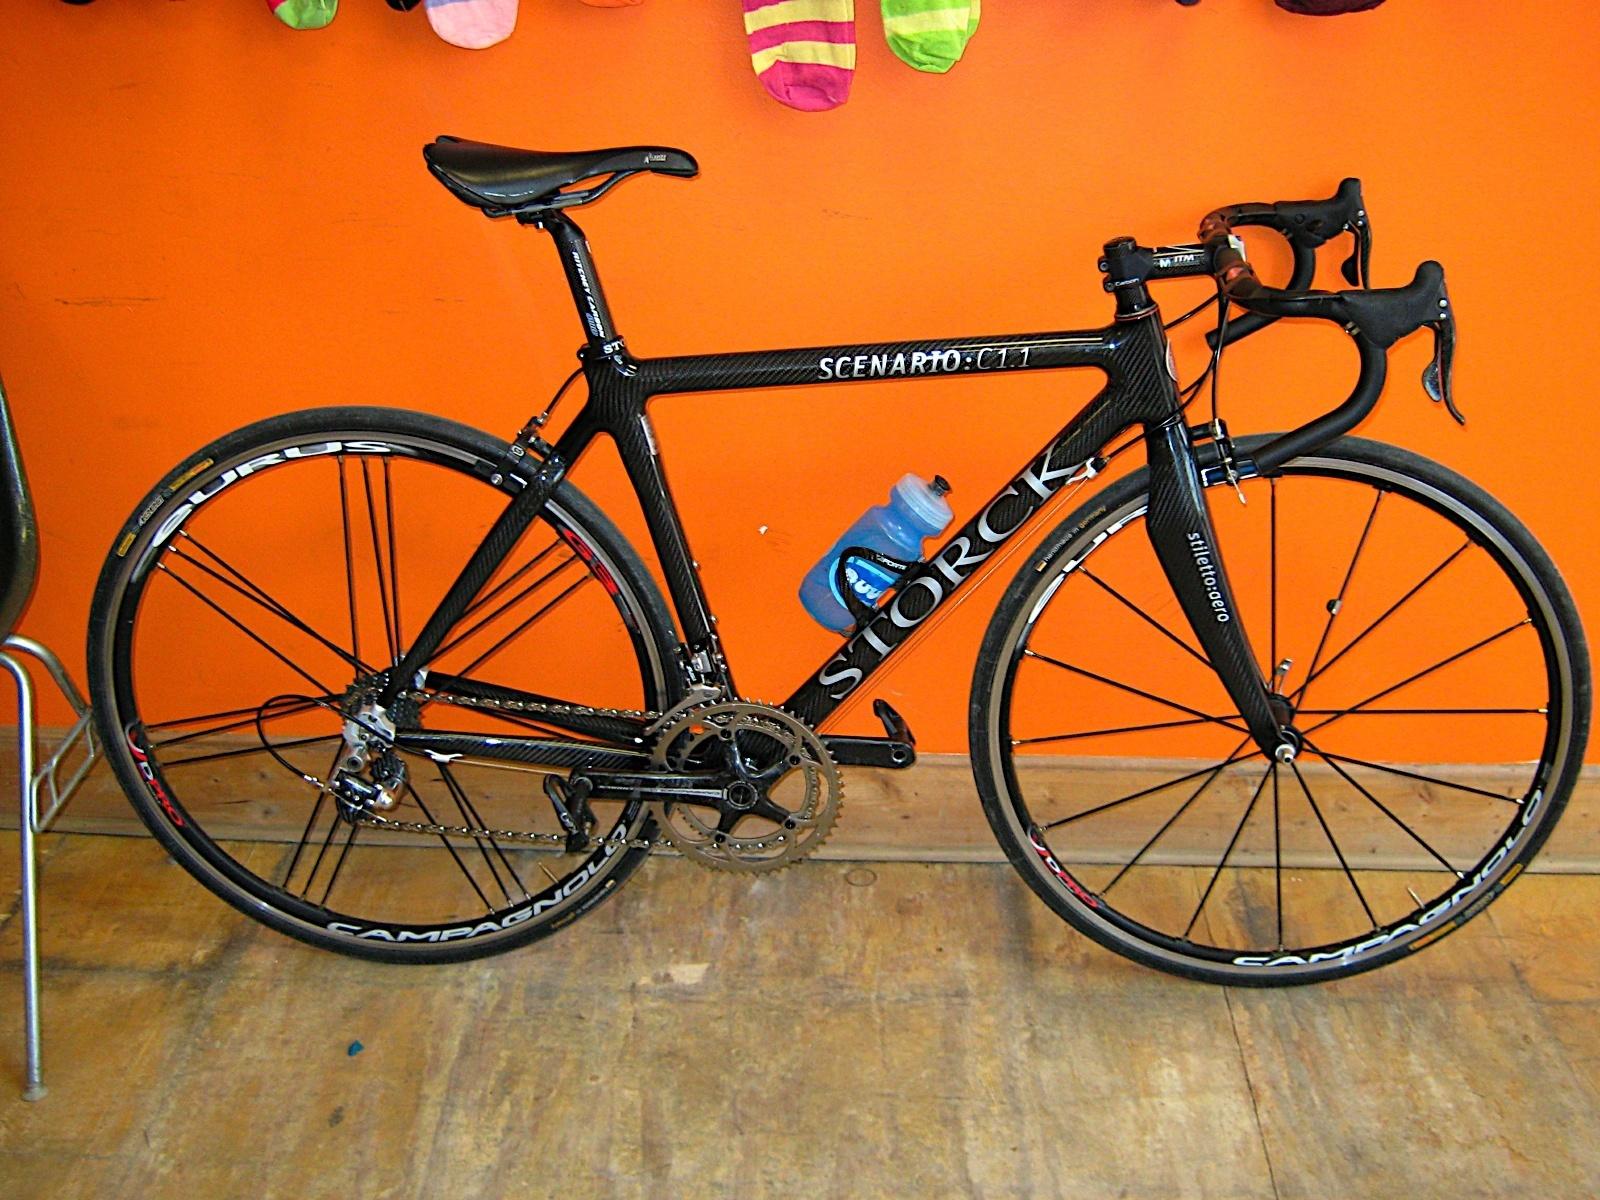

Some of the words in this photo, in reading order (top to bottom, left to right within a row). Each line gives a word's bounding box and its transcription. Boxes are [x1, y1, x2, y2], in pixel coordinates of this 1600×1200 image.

[818, 437, 1088, 700] STORCK
[1188, 531, 1231, 623] stiletto:aero
[325, 822, 627, 943] CAMPAGNOLO
[1233, 788, 1543, 967] CAMPAGNOLO
